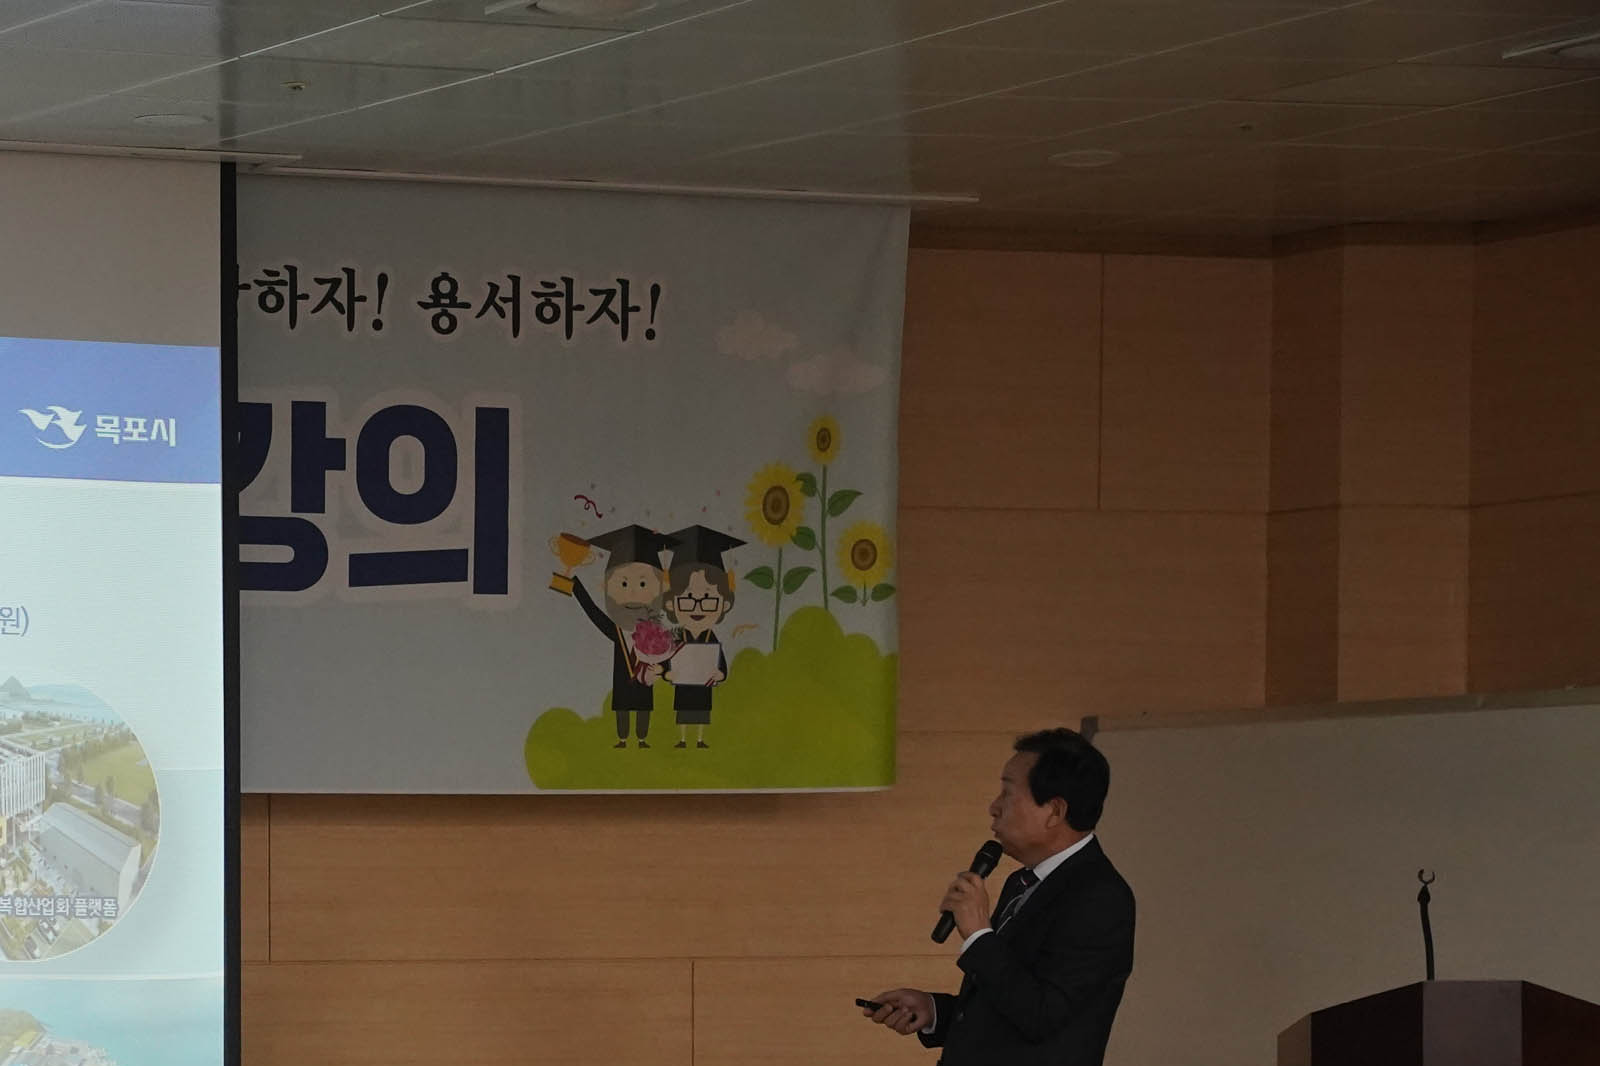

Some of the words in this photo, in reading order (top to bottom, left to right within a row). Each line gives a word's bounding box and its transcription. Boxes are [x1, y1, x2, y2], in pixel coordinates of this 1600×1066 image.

[417, 271, 663, 342] 용서하자!
[94, 414, 177, 448] 목포시
[238, 400, 510, 595] 강의
[74, 897, 119, 918] 플랫폼
